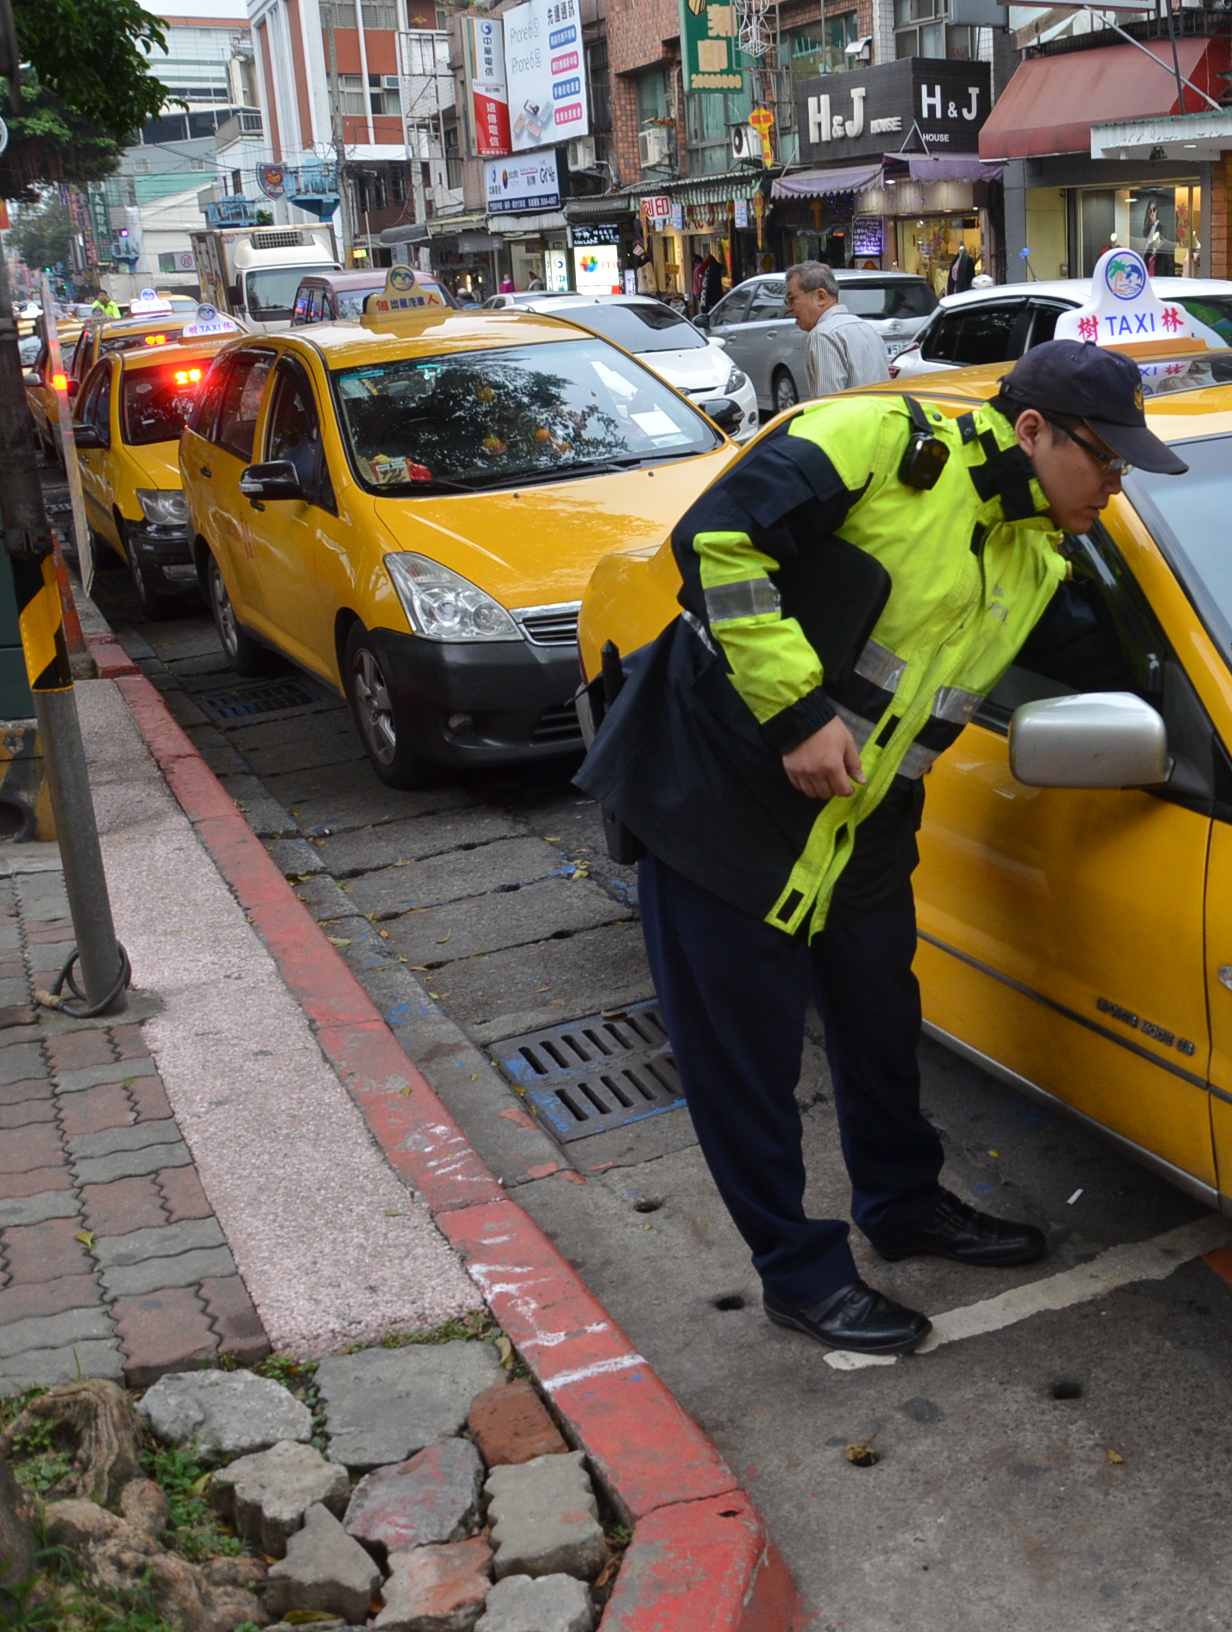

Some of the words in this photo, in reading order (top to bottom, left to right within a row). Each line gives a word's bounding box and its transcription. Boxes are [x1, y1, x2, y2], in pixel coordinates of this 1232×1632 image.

[482, 37, 494, 77] 中華電信
[486, 102, 500, 147] 遠傳電信
[870, 117, 903, 134] HOUSE
[922, 133, 949, 142] HOUSE
[376, 299, 389, 311] 個
[427, 294, 439, 305] 人
[200, 323, 221, 333] TAXI
[1077, 315, 1099, 342] 樹
[1105, 312, 1155, 337] TAXI
[1161, 307, 1185, 333] 林
